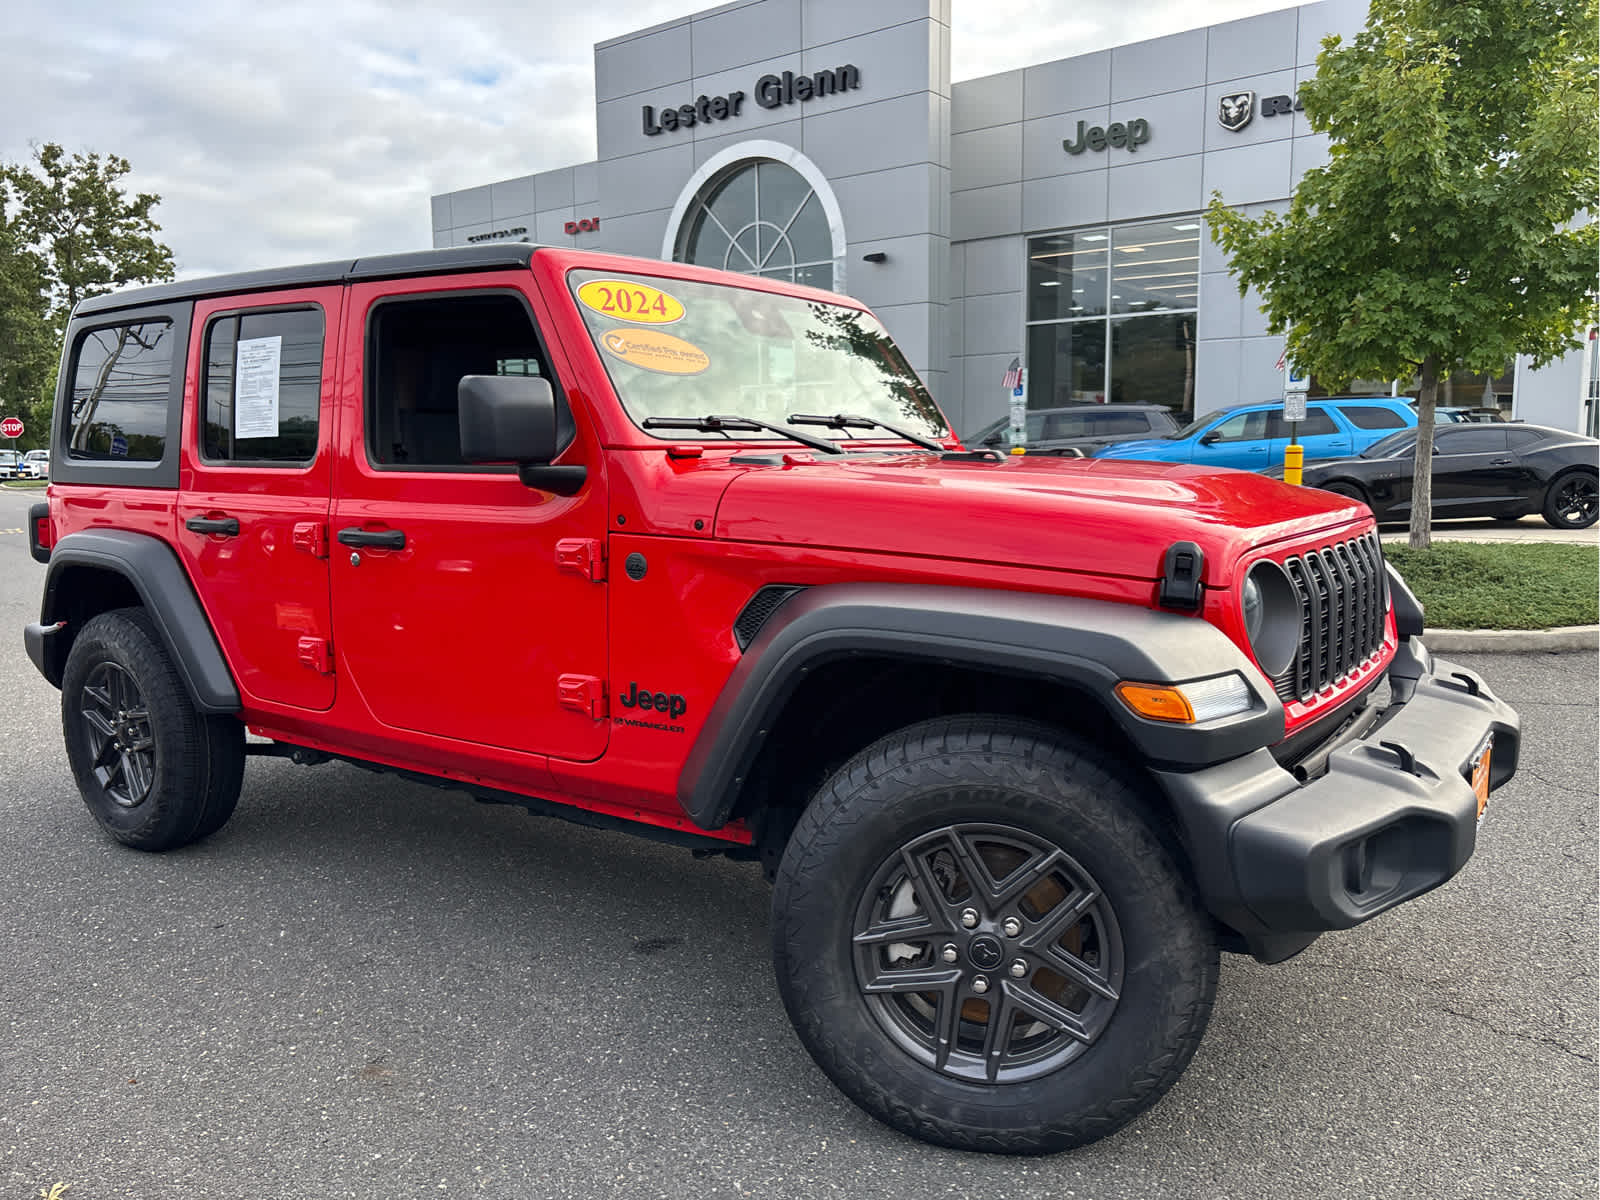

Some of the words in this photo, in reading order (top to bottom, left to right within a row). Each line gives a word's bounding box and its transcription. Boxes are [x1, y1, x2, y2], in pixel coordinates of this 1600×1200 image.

[642, 90, 745, 136] Lester
[754, 63, 860, 110] Glenn
[1063, 118, 1152, 155] Jeep
[598, 287, 667, 316] 2024
[2, 423, 22, 432] STOP
[620, 681, 686, 719] Jeep
